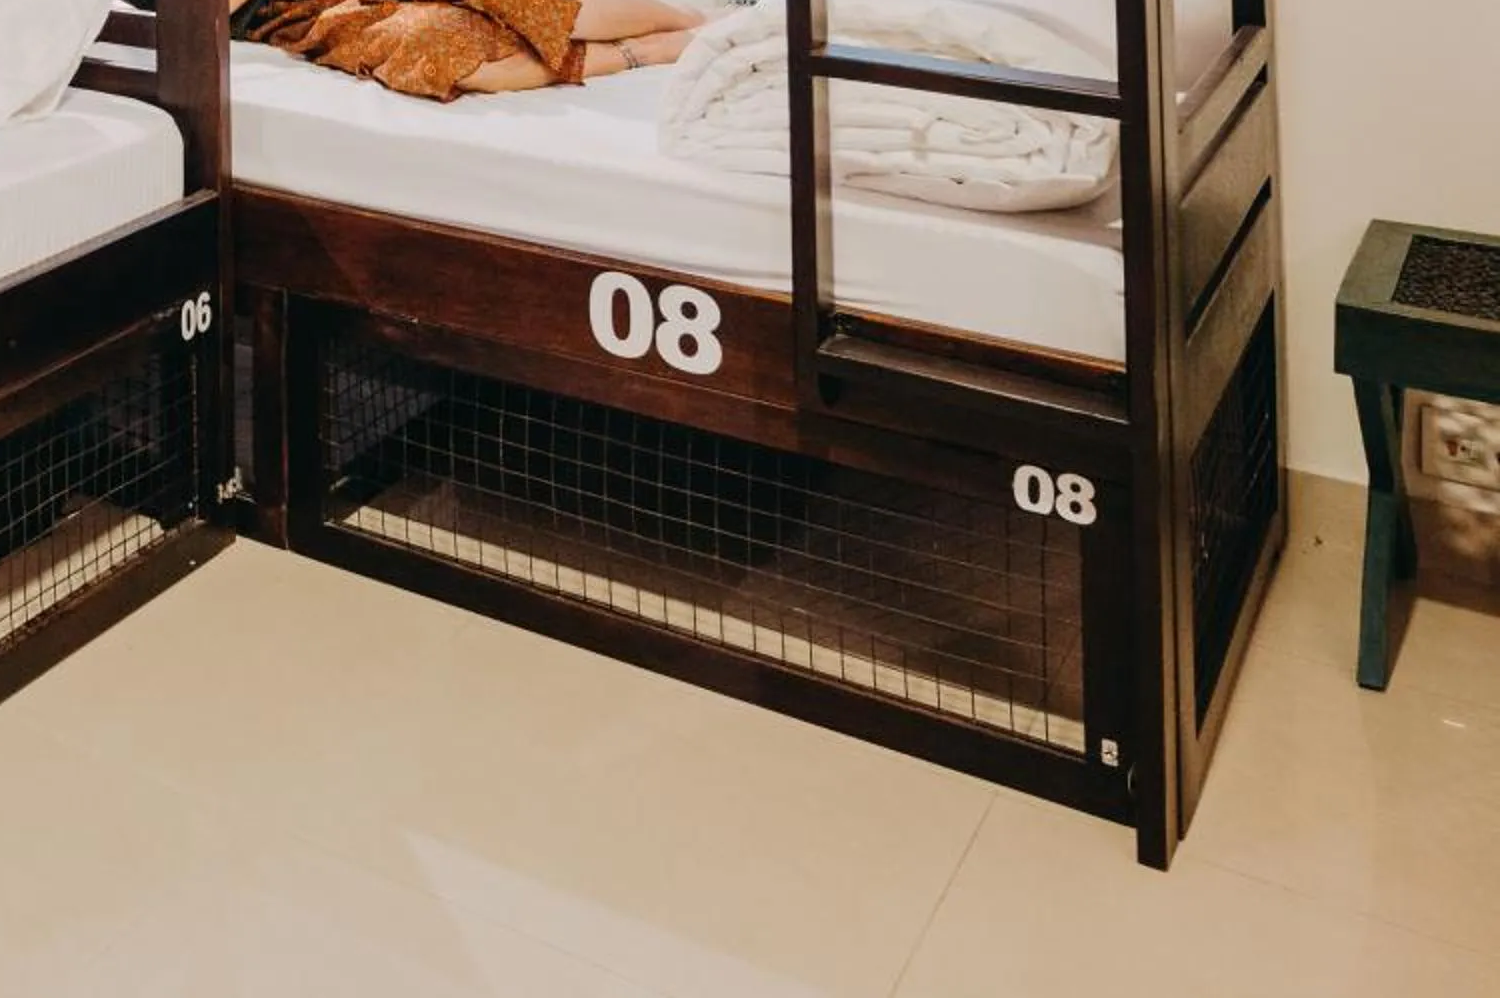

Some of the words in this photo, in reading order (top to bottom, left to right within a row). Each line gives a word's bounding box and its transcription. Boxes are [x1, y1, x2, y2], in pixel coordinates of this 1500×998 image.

[181, 292, 211, 340] 06
[590, 272, 721, 374] 08
[1013, 465, 1096, 525] 08
